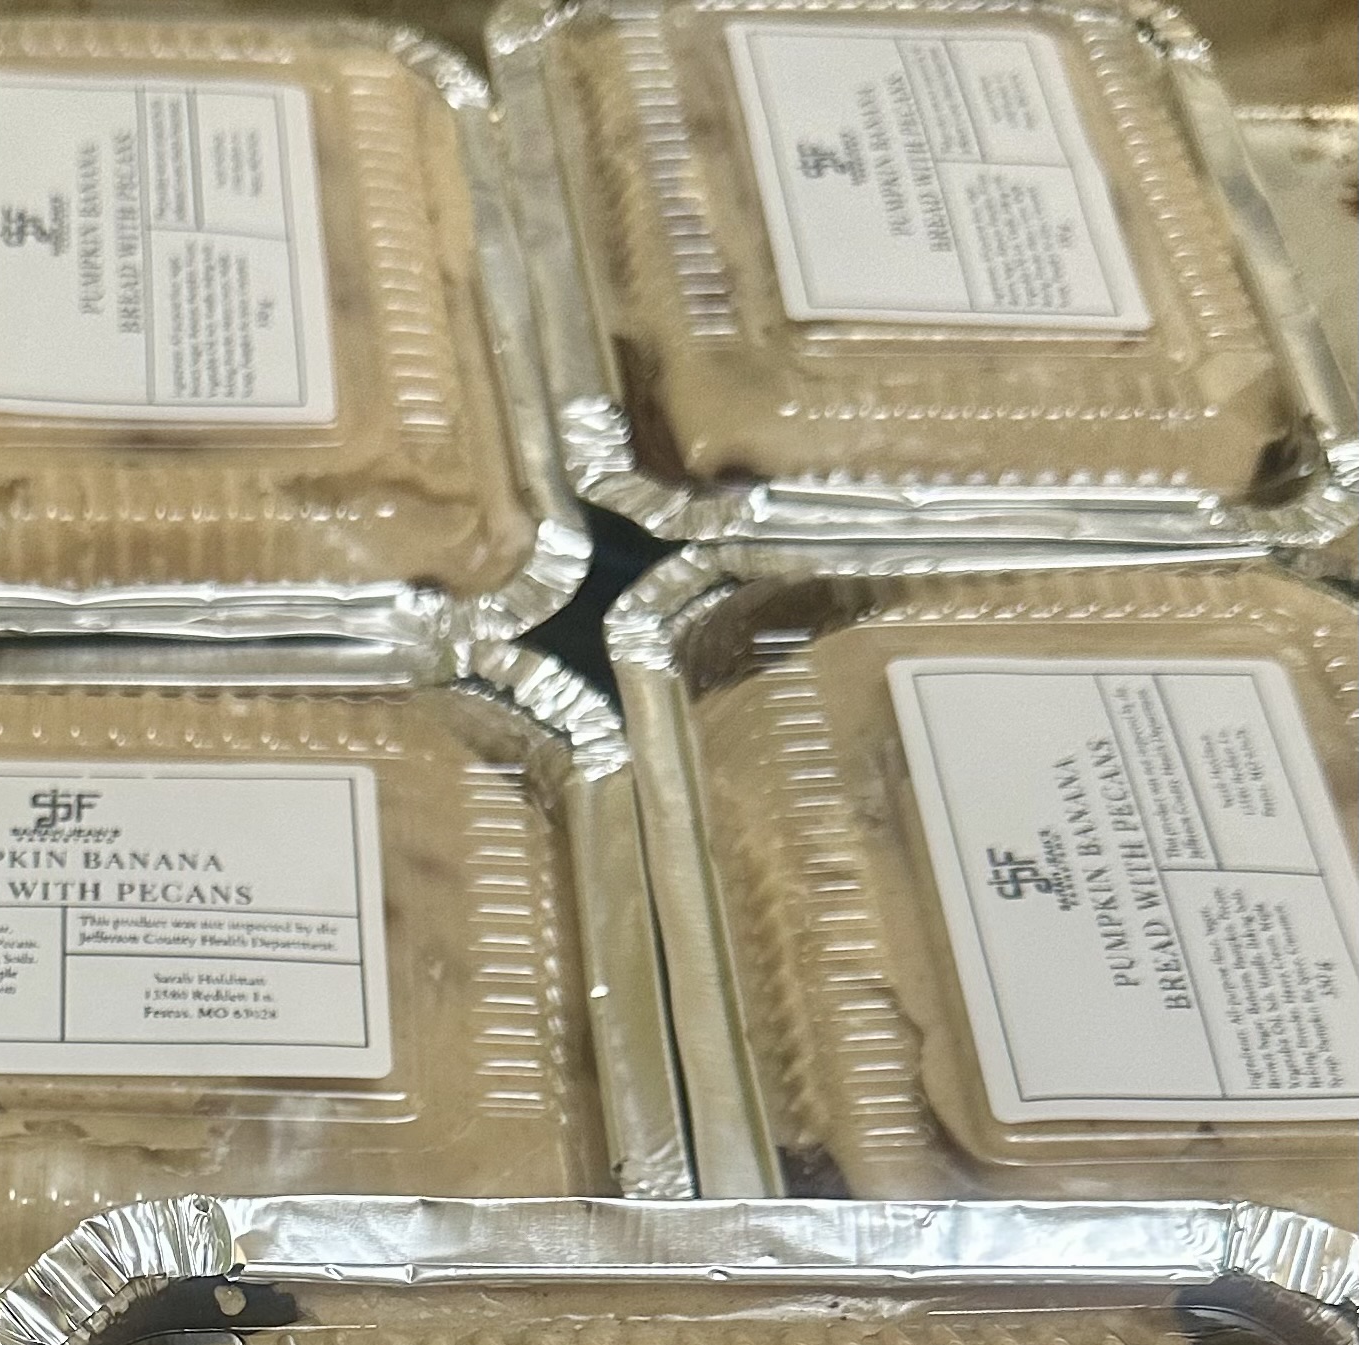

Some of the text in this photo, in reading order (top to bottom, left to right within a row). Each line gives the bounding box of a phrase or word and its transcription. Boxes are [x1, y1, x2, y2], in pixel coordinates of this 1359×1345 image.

[1051, 754, 1104, 855] BANANA
[1085, 737, 1140, 831] PECANS
[8, 880, 103, 905] WITH
[116, 882, 253, 906] PECANS
[83, 849, 223, 872] BANANA
[1118, 839, 1162, 910] WITH
[1082, 865, 1142, 986] PUMPKIN
[1142, 918, 1194, 1009] BREAD
